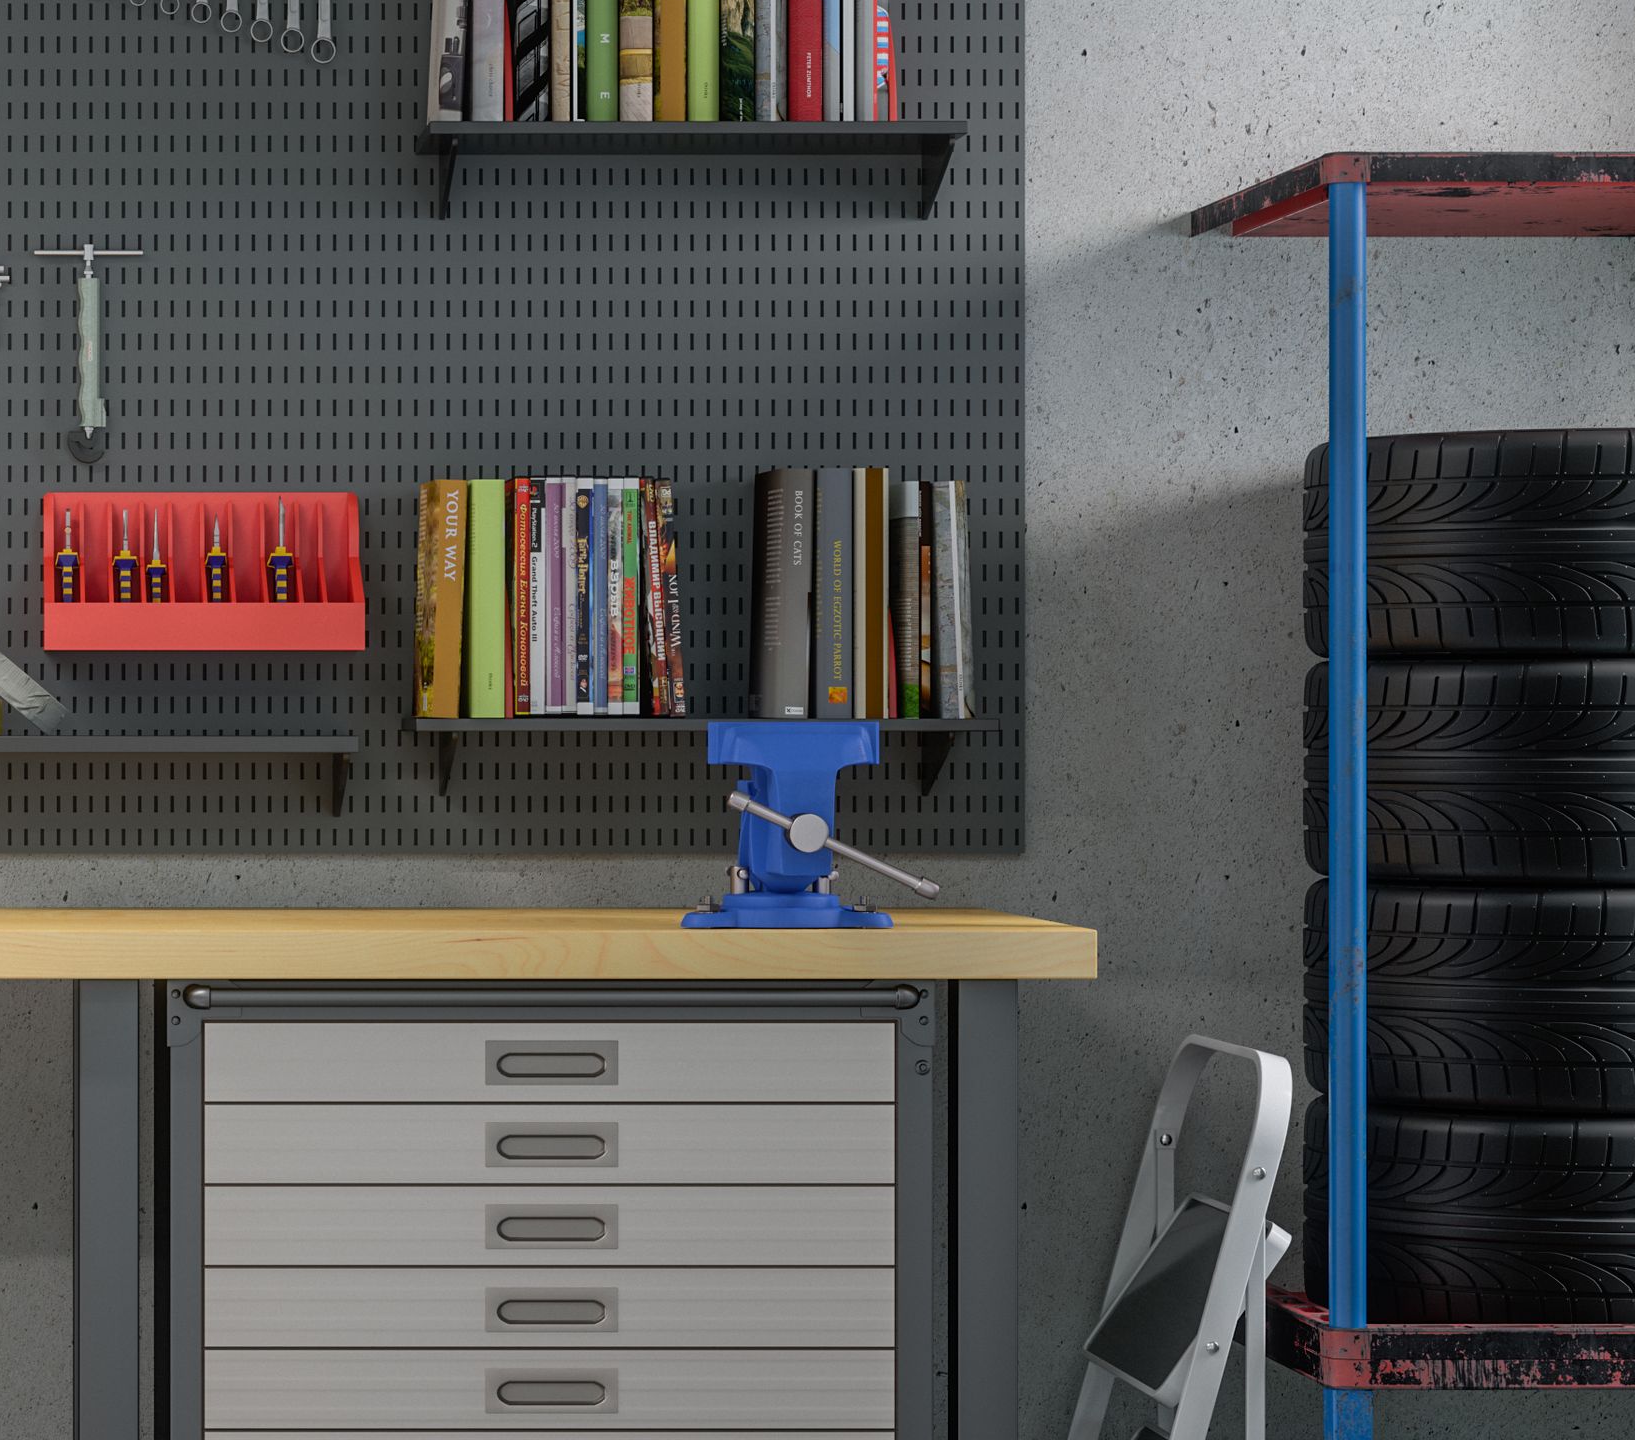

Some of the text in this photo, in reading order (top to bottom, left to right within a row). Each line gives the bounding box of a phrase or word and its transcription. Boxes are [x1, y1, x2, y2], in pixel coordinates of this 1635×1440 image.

[443, 489, 459, 582] YOUR WAY
[793, 490, 804, 566] BOOK OF CATS
[520, 503, 530, 687] Фотосессия Елены Кононовой
[622, 575, 636, 655] ЖИВОТНОЕ
[648, 521, 667, 661] ВЛАДИМИР ВЫСОЦКИЙ
[668, 614, 682, 648] WIND
[833, 540, 842, 681] WORLD OF EGZOTIC PARROT
